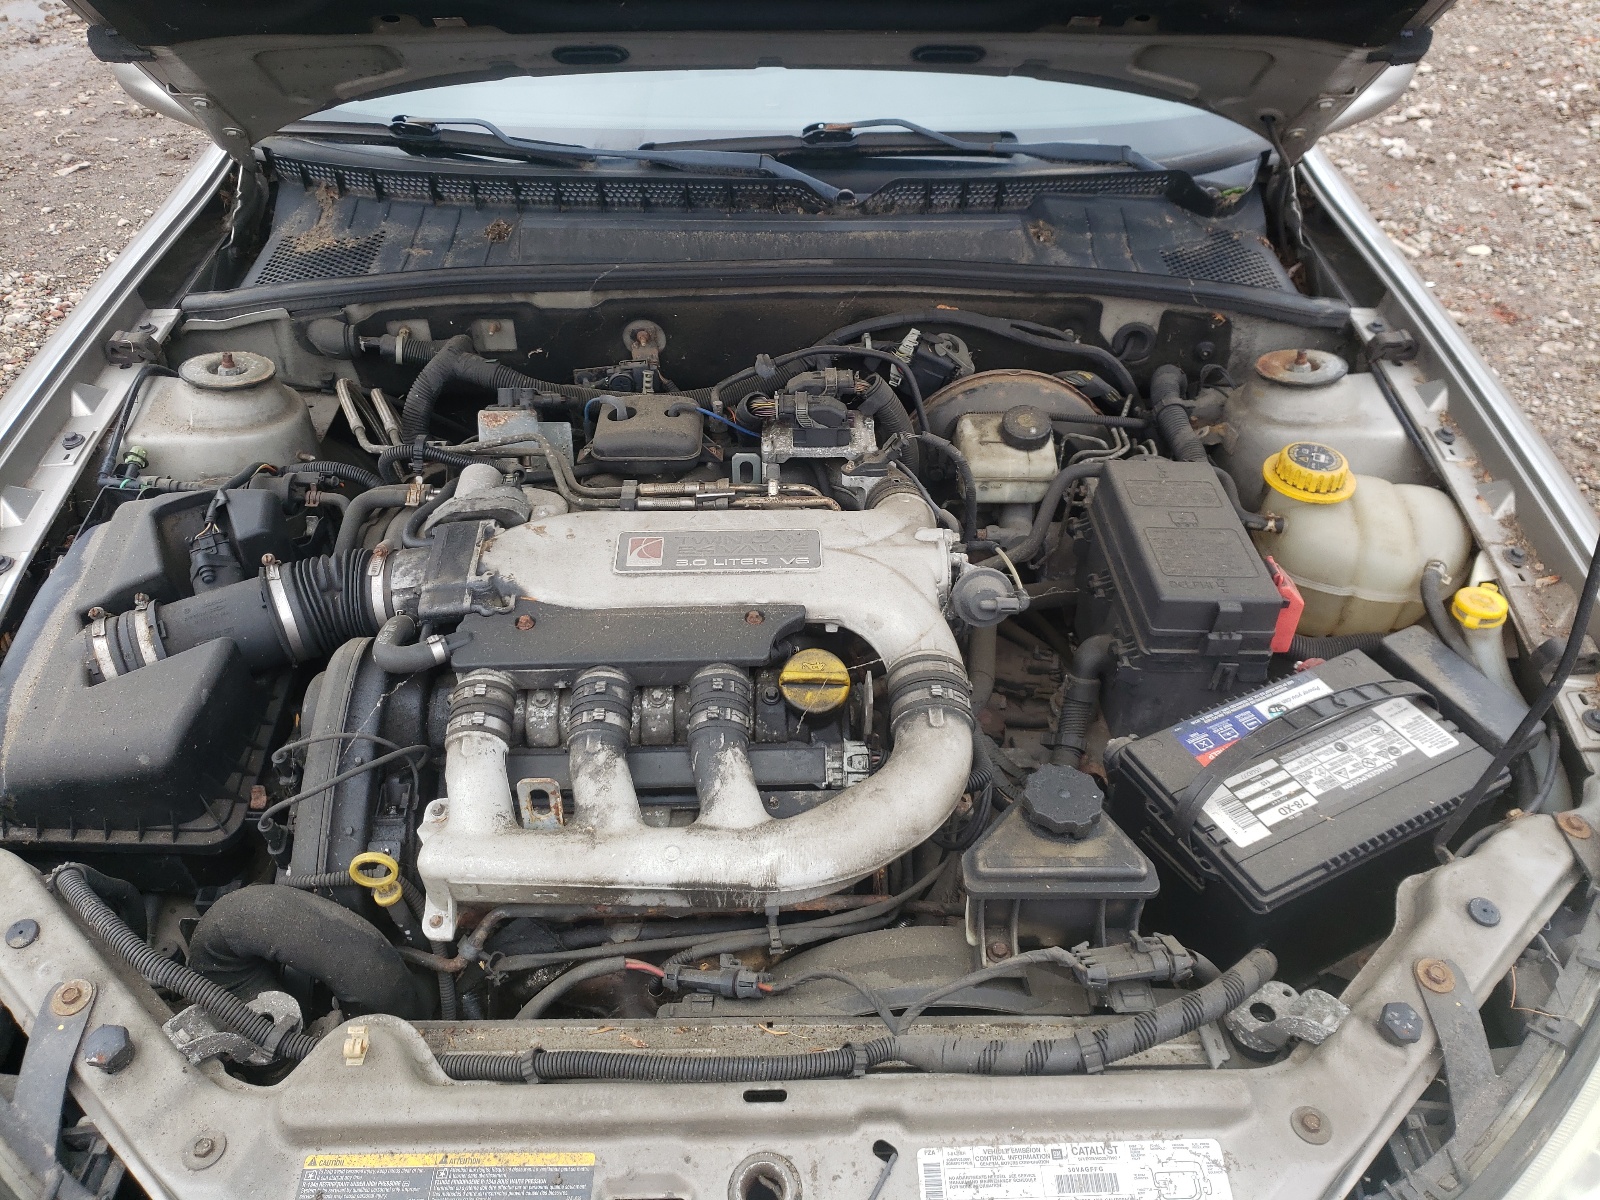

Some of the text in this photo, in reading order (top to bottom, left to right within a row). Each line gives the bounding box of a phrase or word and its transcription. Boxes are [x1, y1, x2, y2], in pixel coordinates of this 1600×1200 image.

[676, 556, 811, 567] 3.0 LITER V6
[1277, 798, 1310, 817] 78-XD
[1071, 1145, 1118, 1156] CATALYST
[318, 1159, 345, 1167] CAUTION
[449, 1157, 481, 1165] ATTENTION
